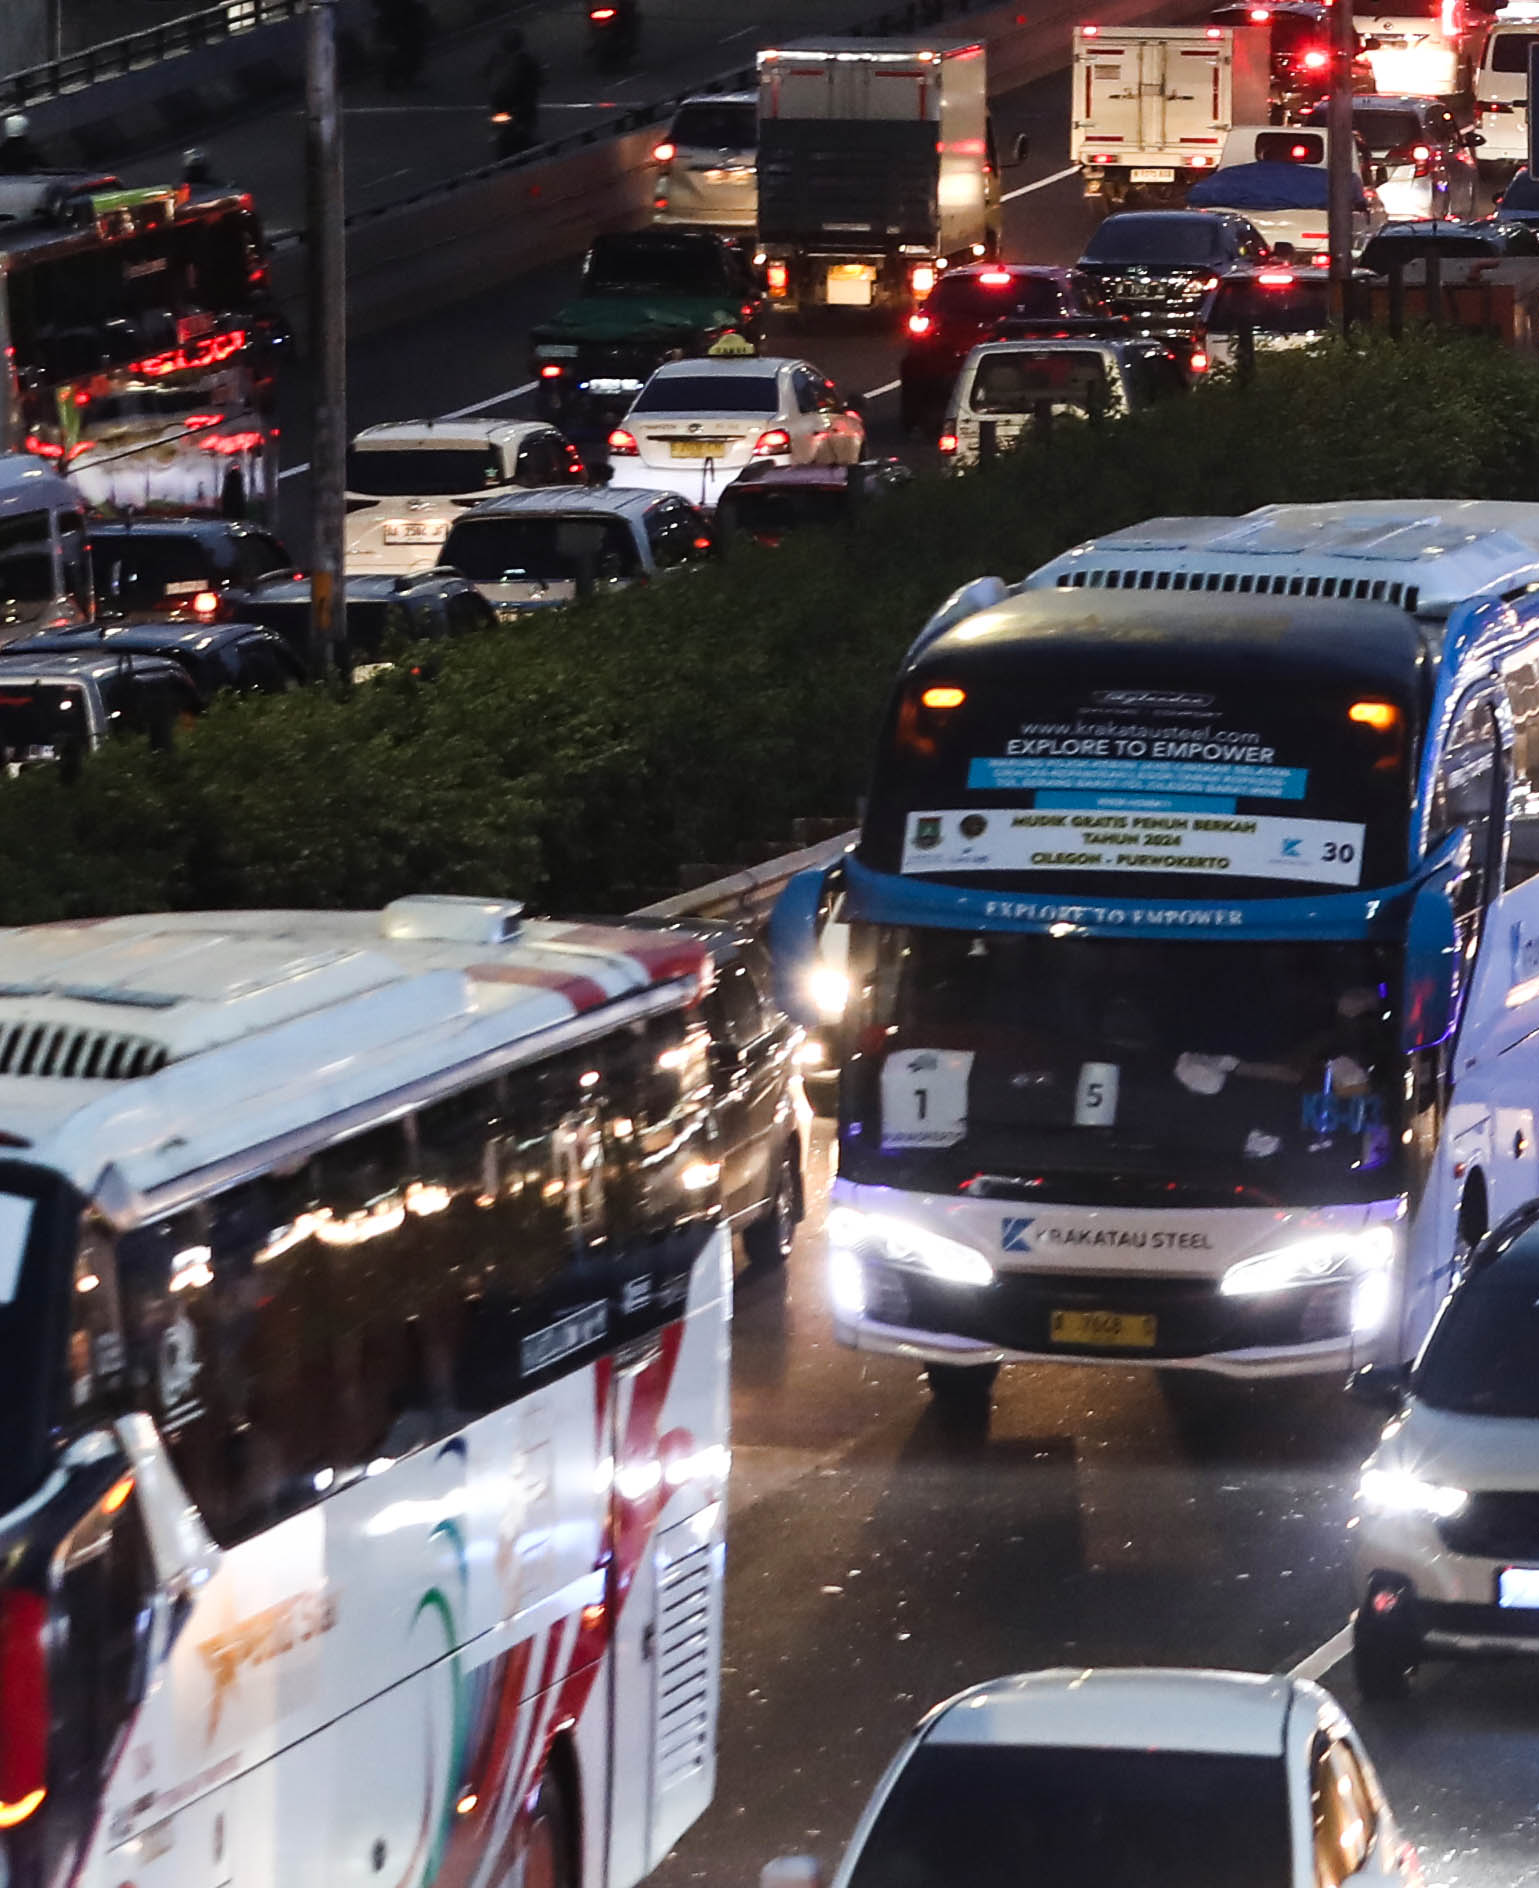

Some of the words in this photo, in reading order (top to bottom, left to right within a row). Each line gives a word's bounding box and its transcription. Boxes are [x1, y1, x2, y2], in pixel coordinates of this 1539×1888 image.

[1007, 739, 1110, 756] EXPLORE
[1115, 740, 1147, 757] TO
[1152, 742, 1275, 763] EMPOWER
[1011, 814, 1068, 830] MUDIK
[1071, 815, 1128, 830] GRATIS
[1132, 816, 1190, 832] PENUH
[1193, 818, 1257, 834] BERKAH
[1083, 832, 1139, 847] TAHUN
[1031, 851, 1102, 866] CILEGON
[1116, 854, 1231, 870] PURWOKERTO
[1320, 842, 1355, 864] 30
[986, 900, 1084, 923] EXPLORE
[1096, 906, 1125, 924] TO
[1132, 907, 1244, 927] EMPOWER
[1085, 1083, 1104, 1108] 5
[1151, 1231, 1213, 1250] STEEL
